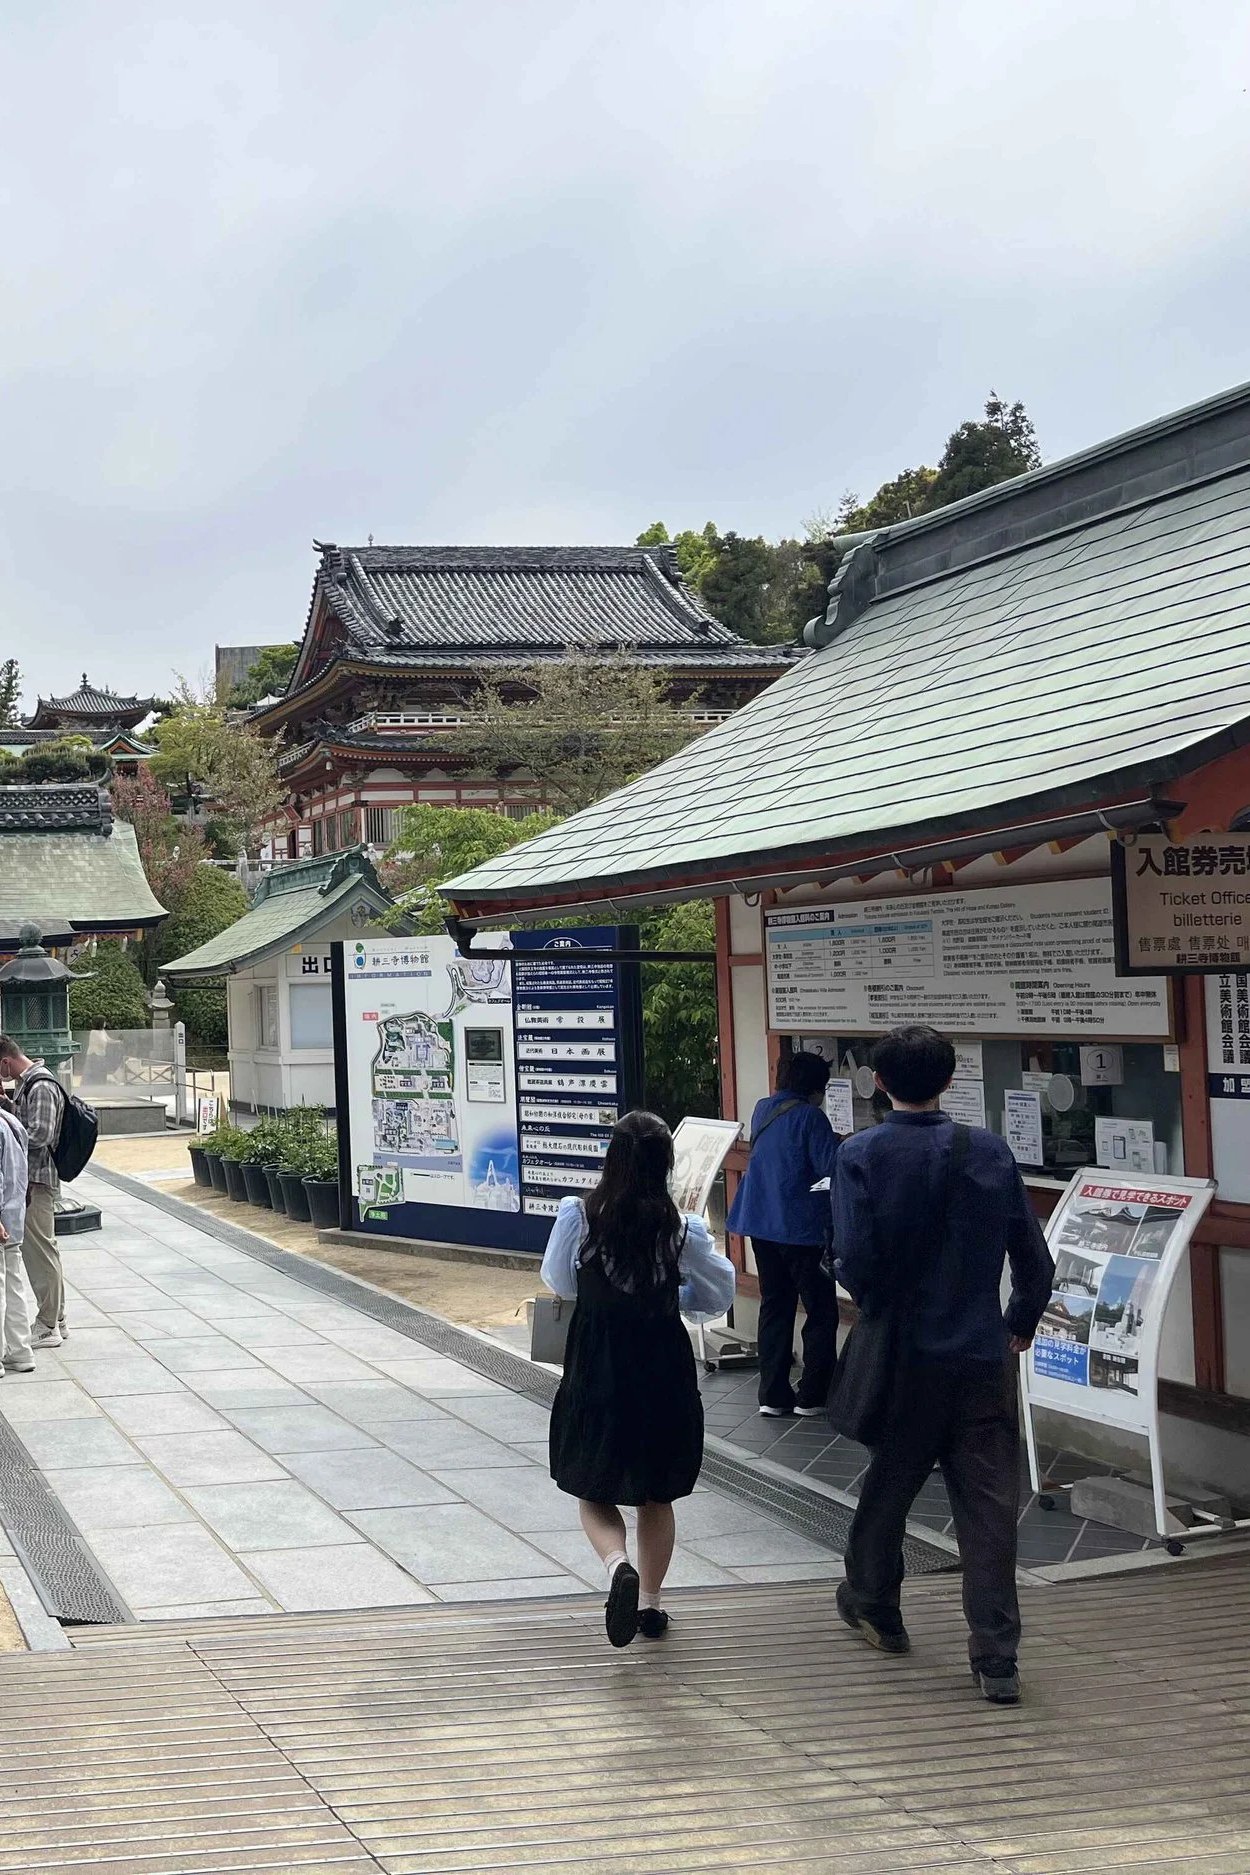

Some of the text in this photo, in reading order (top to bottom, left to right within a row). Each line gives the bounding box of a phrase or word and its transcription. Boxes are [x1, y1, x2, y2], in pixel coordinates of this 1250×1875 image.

[1136, 845, 1250, 877] 入館券売
[1159, 891, 1250, 906] Ticket Office
[1173, 913, 1242, 927] billetterie
[1138, 935, 1230, 952] 售票處 售票处
[372, 954, 430, 966] 耕三寺博物館
[1176, 953, 1241, 964] 耕三寺博物館
[1096, 1053, 1106, 1069] 1
[1084, 1186, 1187, 1207] 入館券で見学できるスポット
